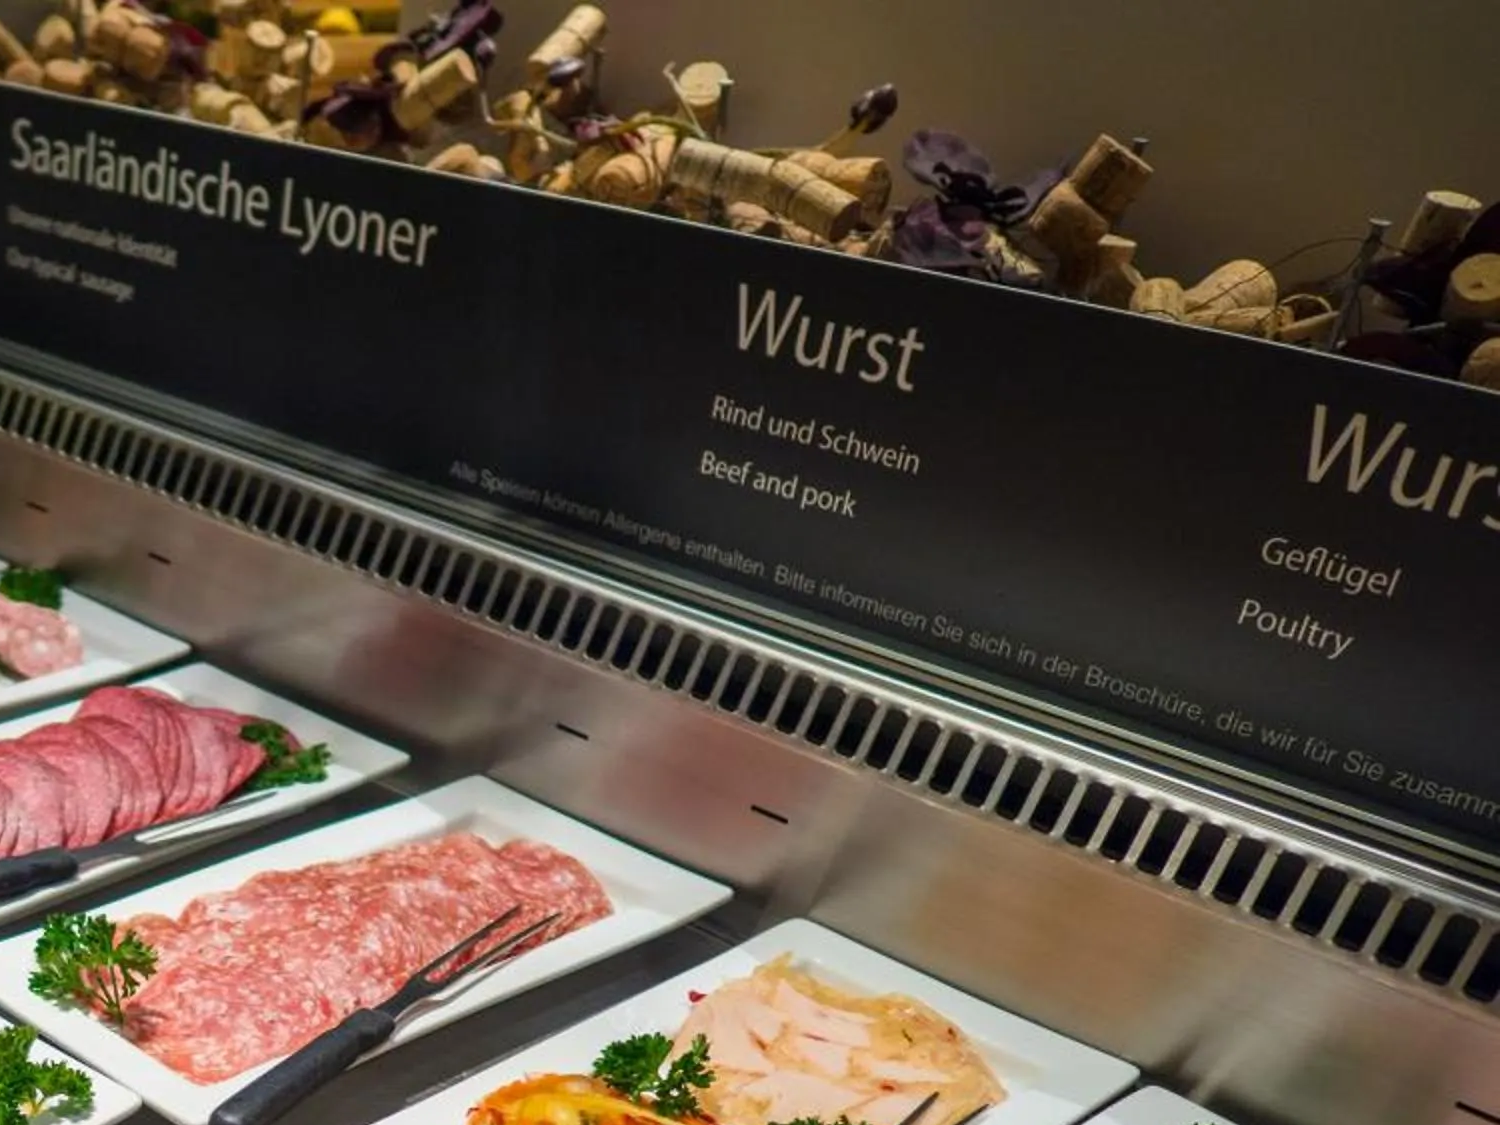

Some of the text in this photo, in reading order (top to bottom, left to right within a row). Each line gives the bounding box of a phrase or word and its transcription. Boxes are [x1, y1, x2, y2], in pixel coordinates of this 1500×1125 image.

[9, 117, 438, 268] Saarländische Lyoner
[737, 283, 924, 391] Wurst
[711, 395, 921, 475] Rind und Schwein
[699, 450, 858, 518] Beef and pork
[1261, 537, 1402, 598] Geflügel
[602, 508, 682, 551] Allergene
[774, 564, 816, 595] Bitte
[819, 580, 928, 631] informieren
[931, 615, 964, 643] Sie
[968, 629, 1013, 659] sich
[1016, 642, 1037, 668] in
[1041, 654, 1080, 682] der
[1215, 711, 1254, 738] die
[1260, 726, 1297, 752] wir
[1303, 736, 1338, 767] für
[1342, 750, 1386, 782] Sie
[1237, 598, 1354, 660] Poultry
